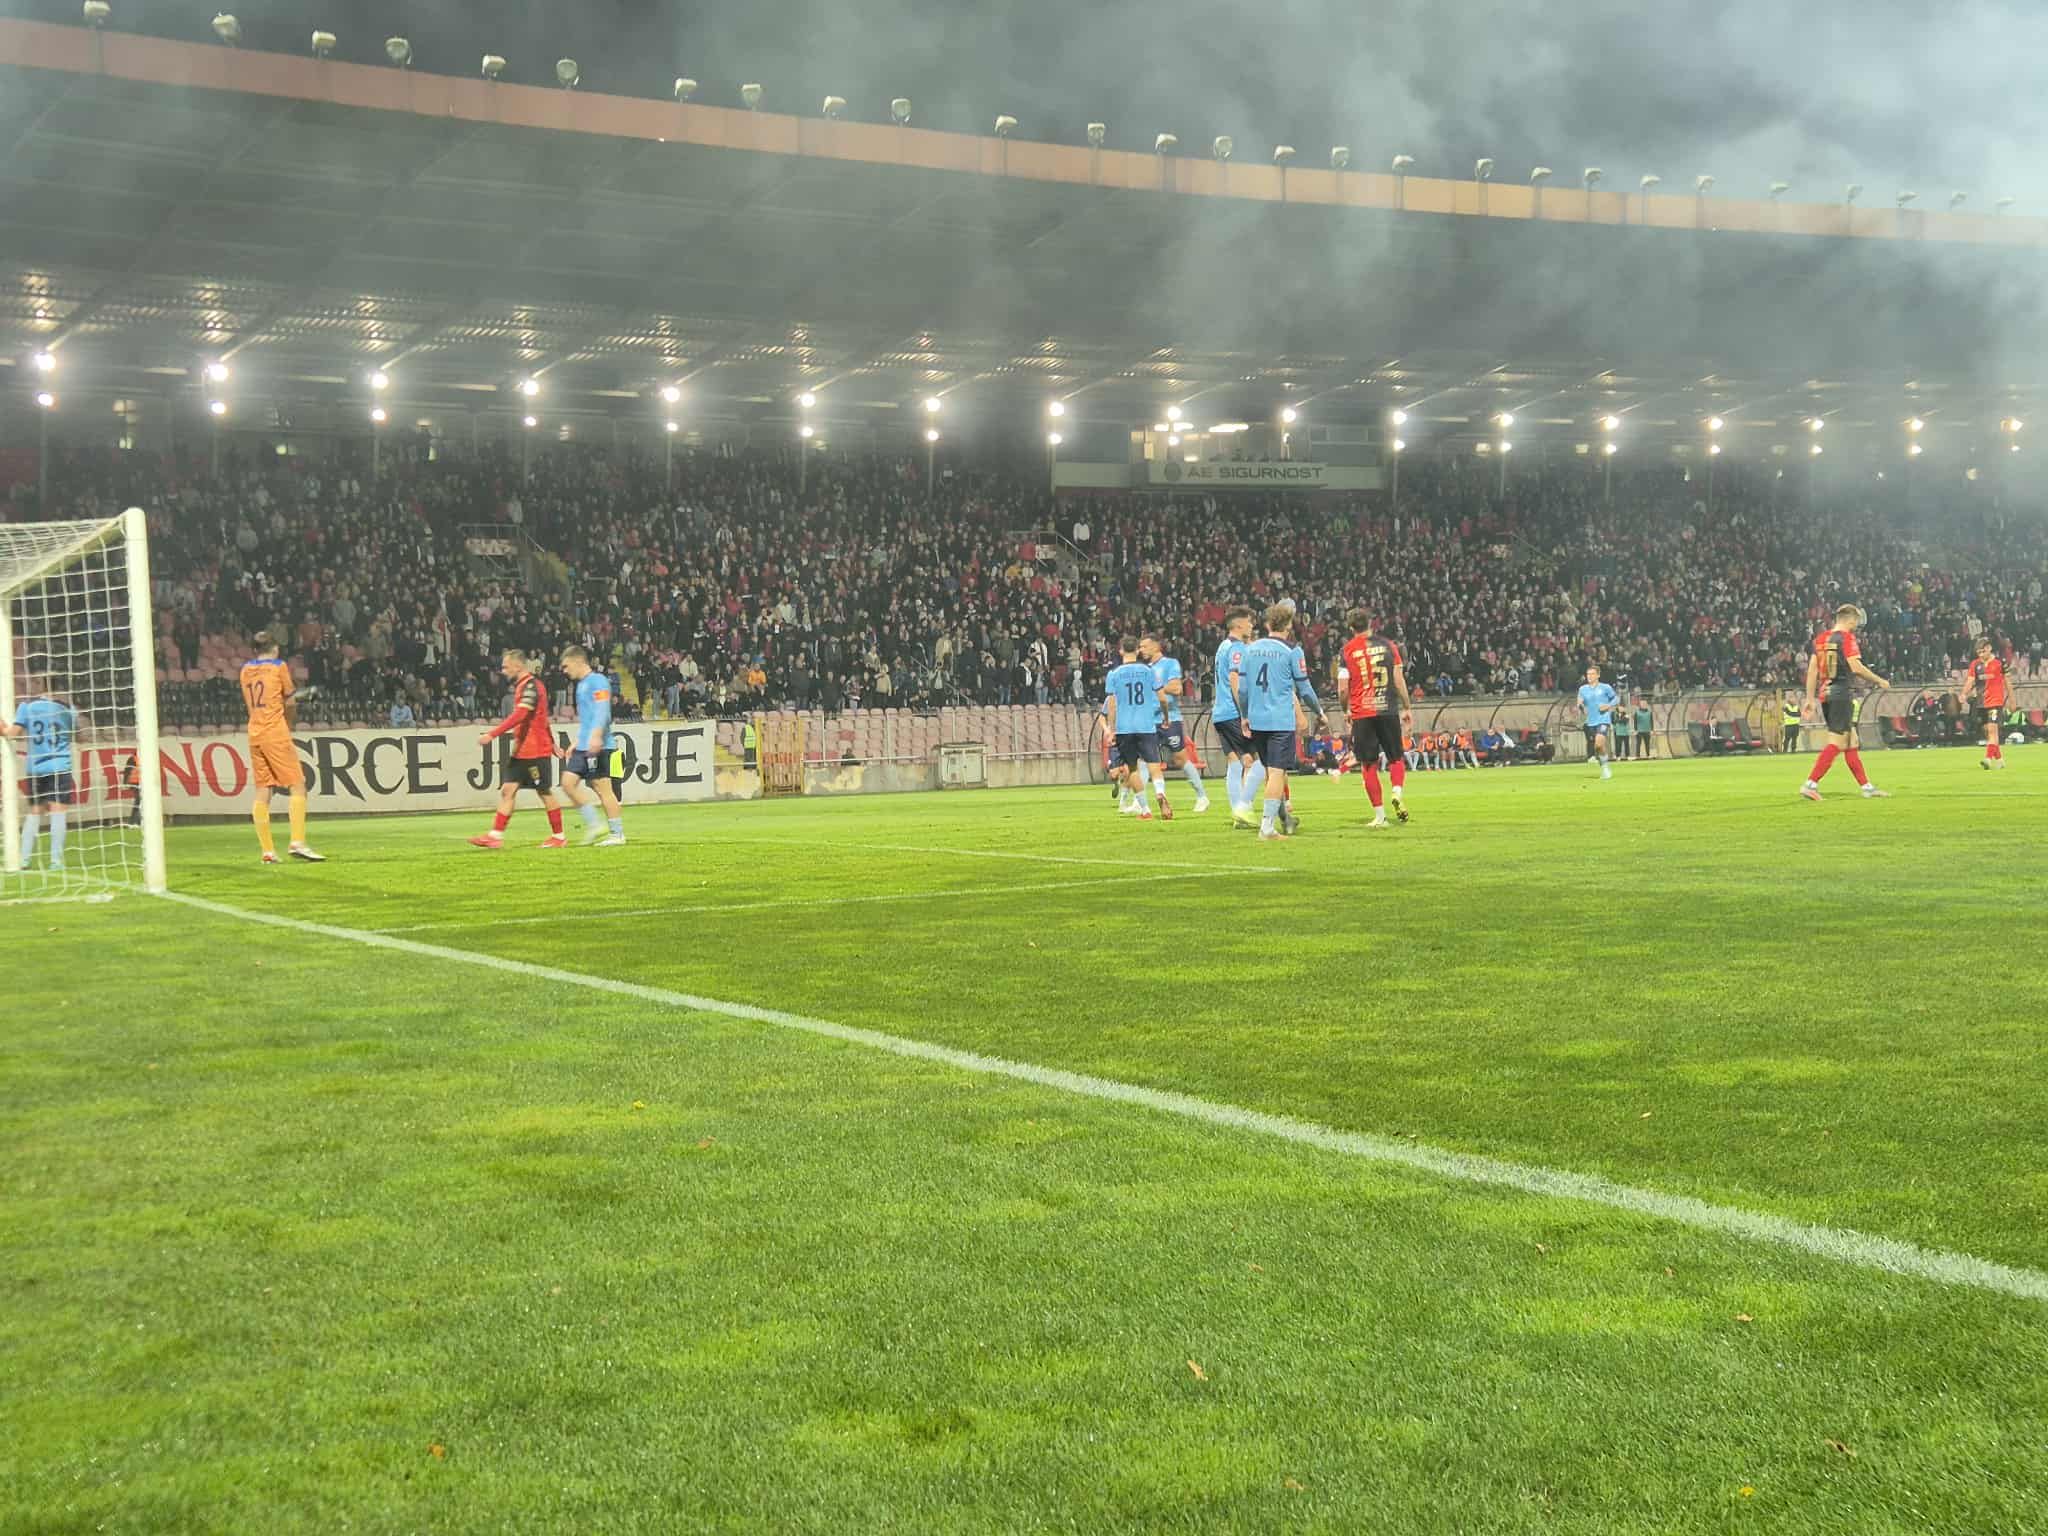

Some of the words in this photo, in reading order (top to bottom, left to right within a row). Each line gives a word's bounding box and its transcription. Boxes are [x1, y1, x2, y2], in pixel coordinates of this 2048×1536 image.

[1219, 466, 1323, 479] SIGURNOST
[1256, 662, 1269, 693] 4
[1359, 655, 1389, 688] 15
[247, 680, 266, 708] 12
[1125, 681, 1145, 706] 18
